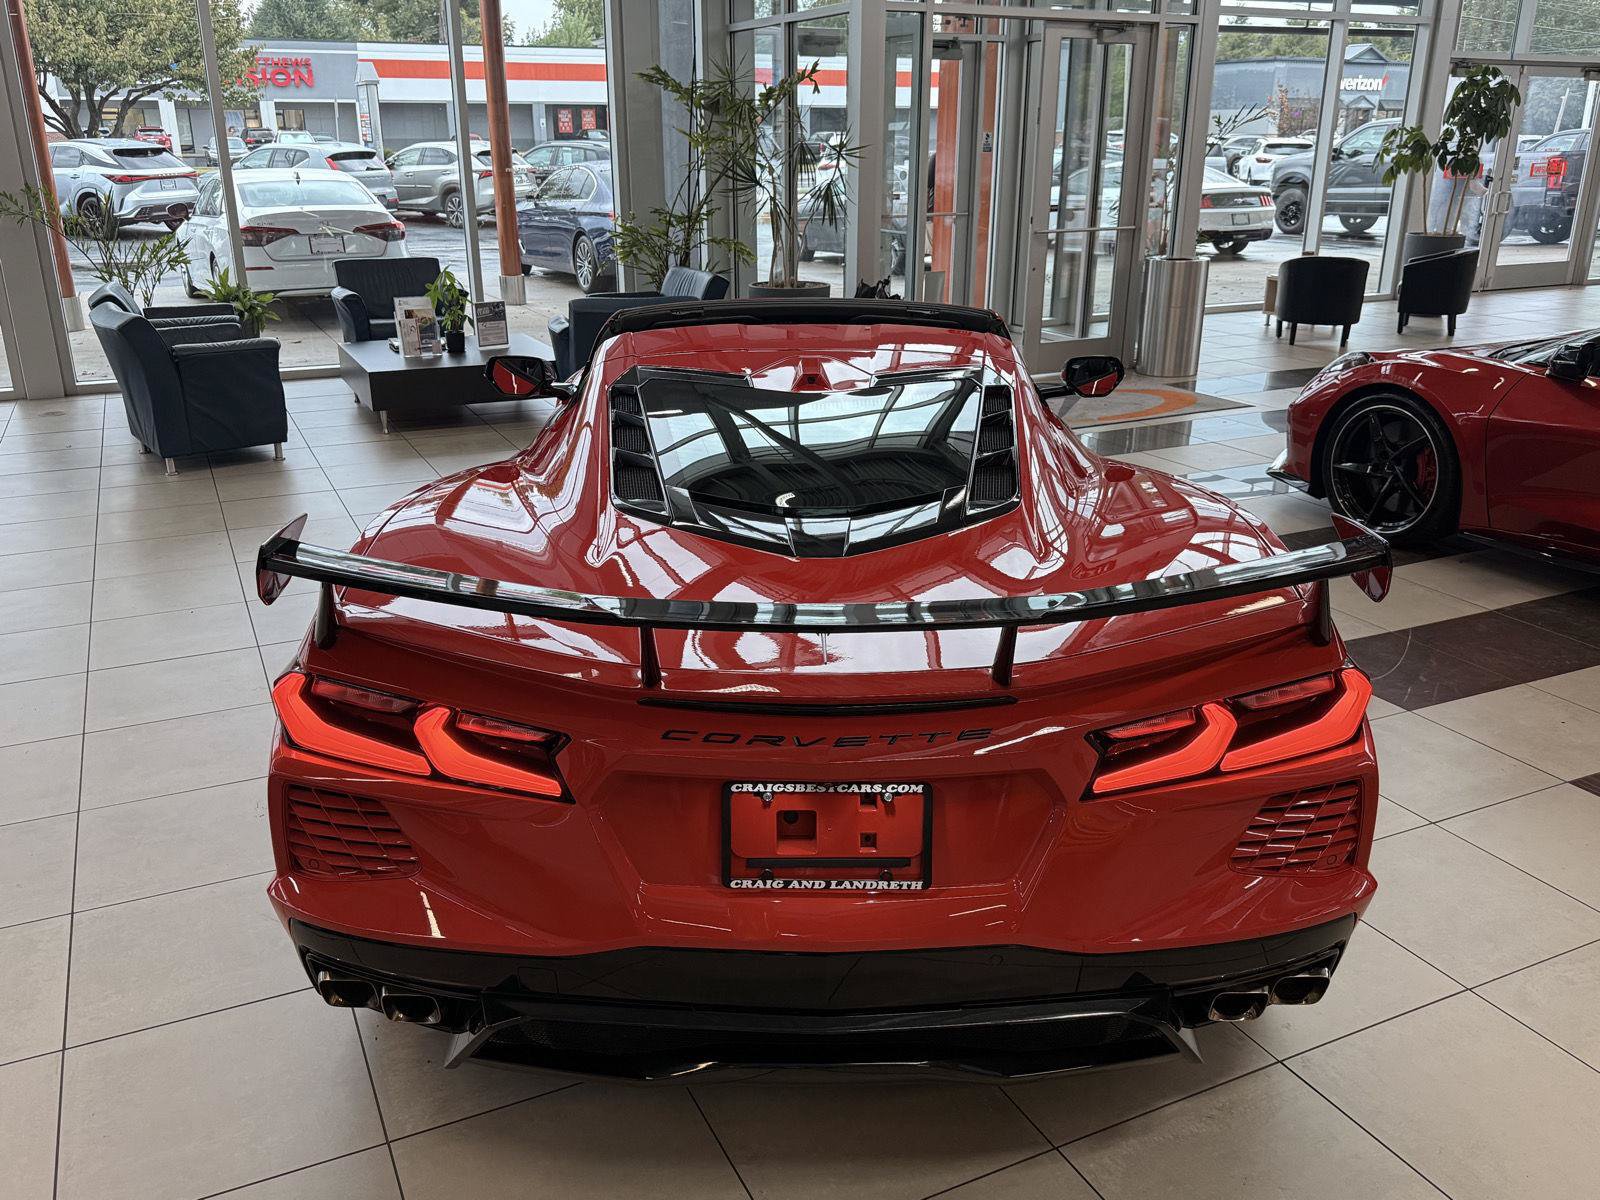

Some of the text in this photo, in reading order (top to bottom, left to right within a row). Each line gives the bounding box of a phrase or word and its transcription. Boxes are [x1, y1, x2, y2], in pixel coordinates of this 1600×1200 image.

[255, 57, 312, 67] TTHEWS
[236, 66, 315, 88] SION
[661, 728, 994, 748] CORVETTE
[729, 880, 924, 890] CRAIG AND LANDRETH
